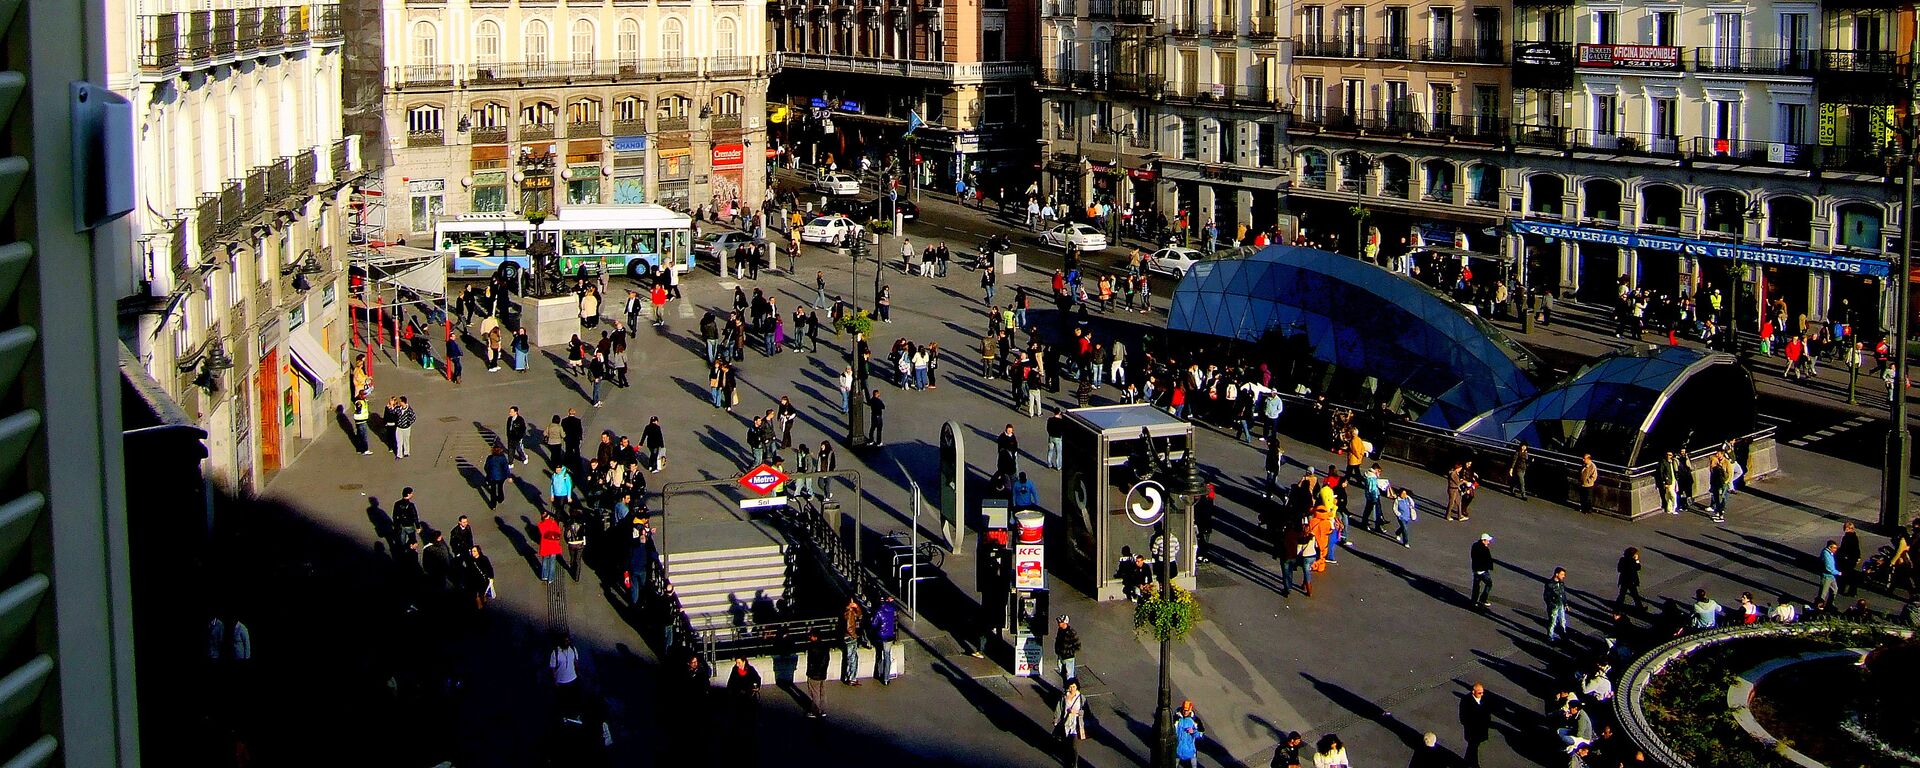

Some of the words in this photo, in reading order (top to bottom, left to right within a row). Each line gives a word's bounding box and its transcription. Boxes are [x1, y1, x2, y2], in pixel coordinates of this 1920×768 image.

[1613, 46, 1638, 58] OFICINA
[1639, 47, 1676, 60] DISPONIBLE
[1530, 225, 1629, 245] ZAPATERIAS
[1638, 238, 1707, 254] NUEVOS
[1716, 248, 1861, 273] GUERRILLEROS
[1018, 663, 1039, 671] KFC
